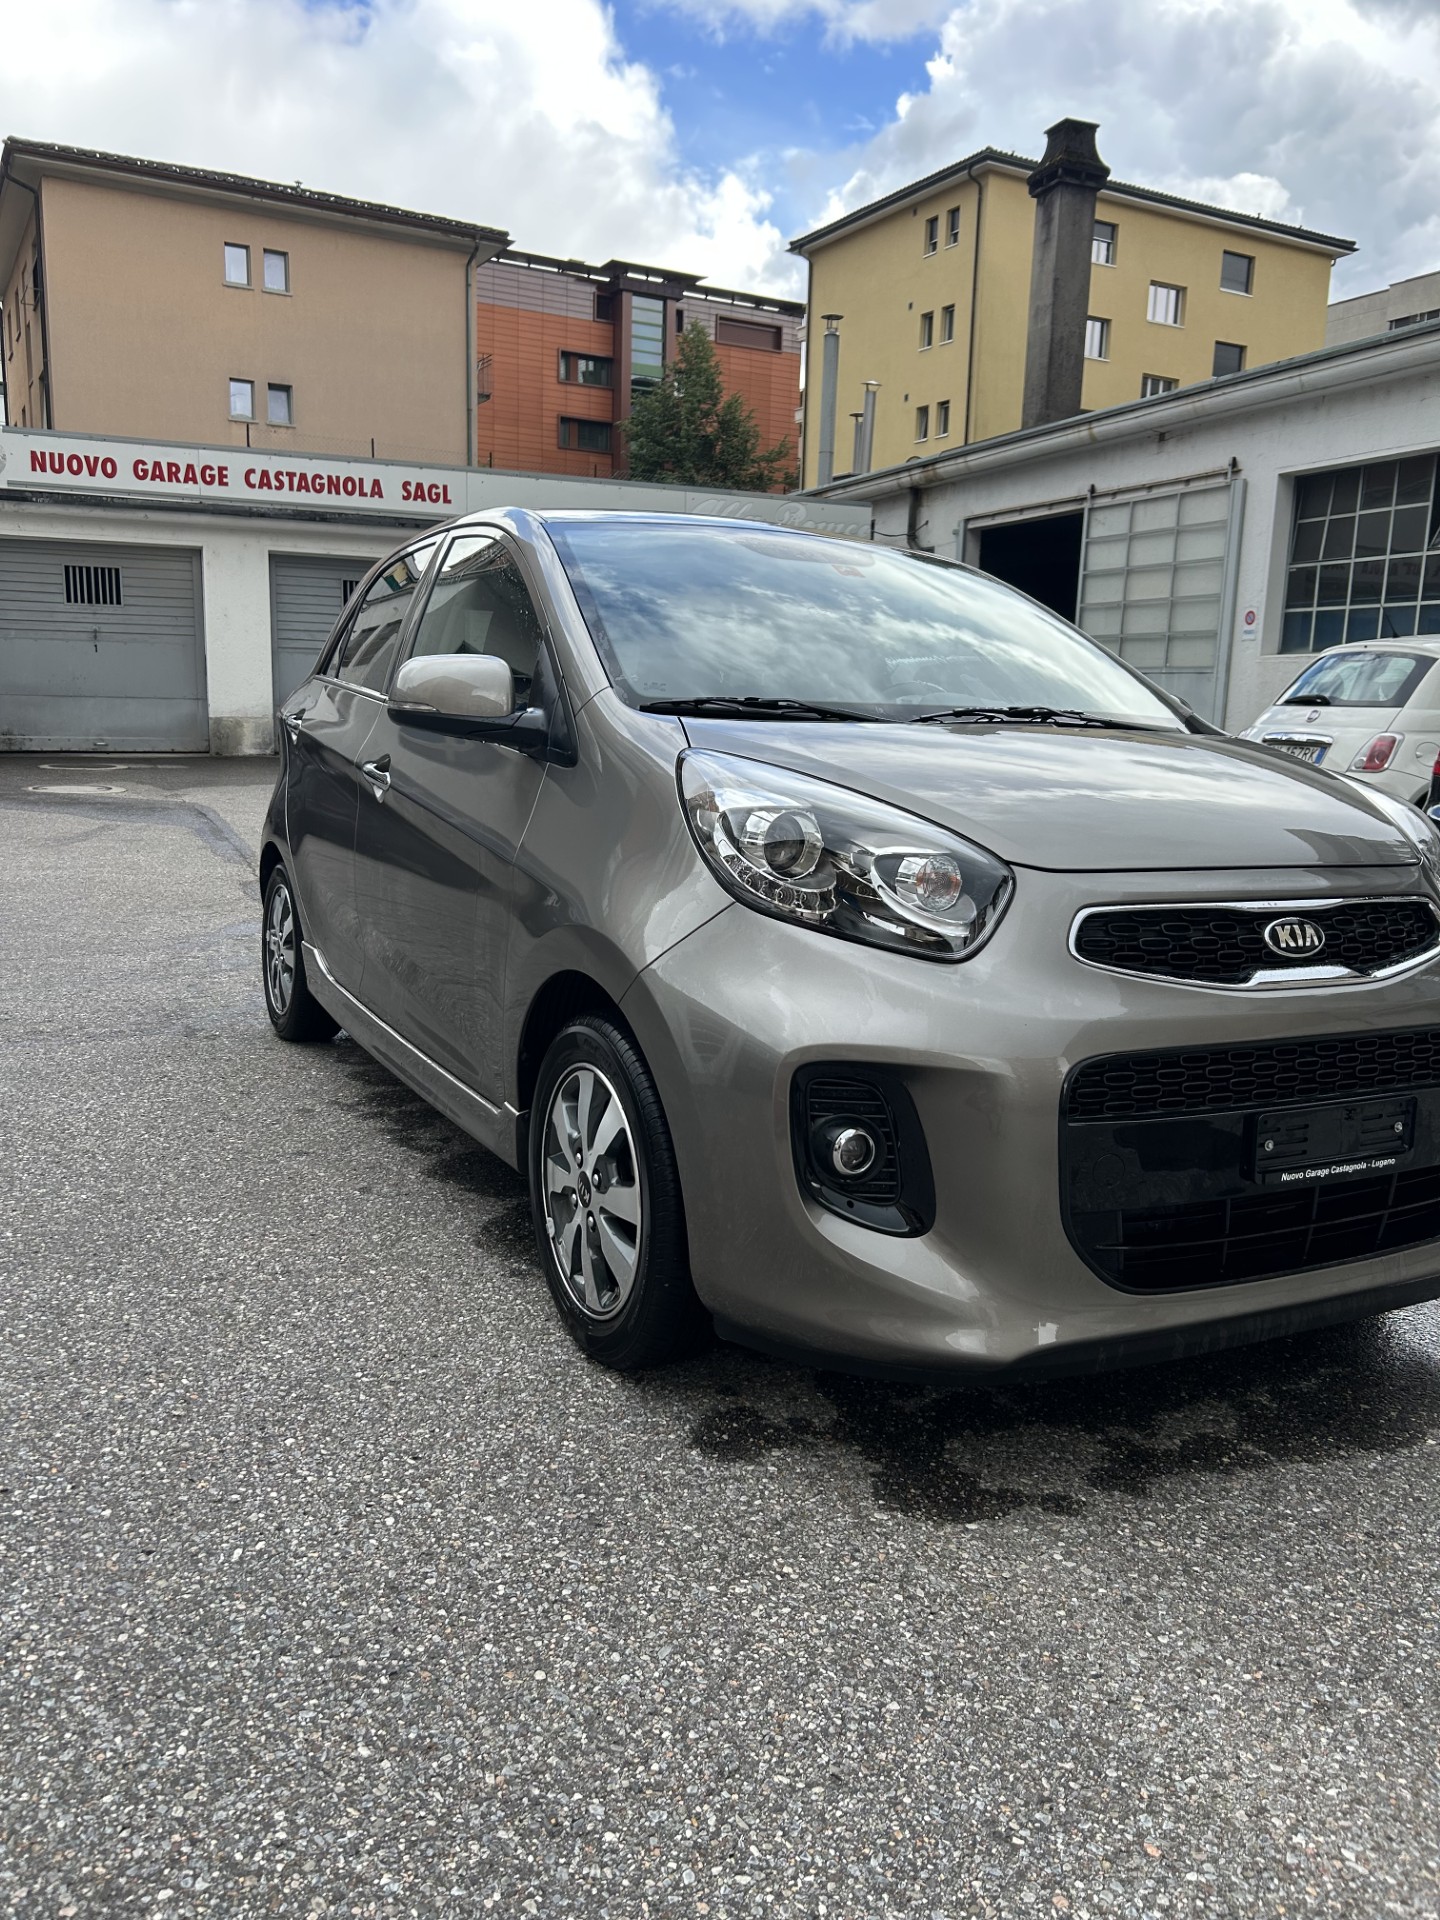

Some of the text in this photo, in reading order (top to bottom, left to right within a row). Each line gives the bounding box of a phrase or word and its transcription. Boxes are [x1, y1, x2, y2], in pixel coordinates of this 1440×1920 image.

[30, 450, 452, 504] NUOVO GARAGE CASTAGNOLA SAGL
[1274, 924, 1320, 948] KIA
[1281, 1172, 1304, 1182] Nuovo
[1305, 1168, 1330, 1178] Garage
[1331, 1161, 1367, 1173] Castagnola
[1371, 1158, 1396, 1169] Lugano
